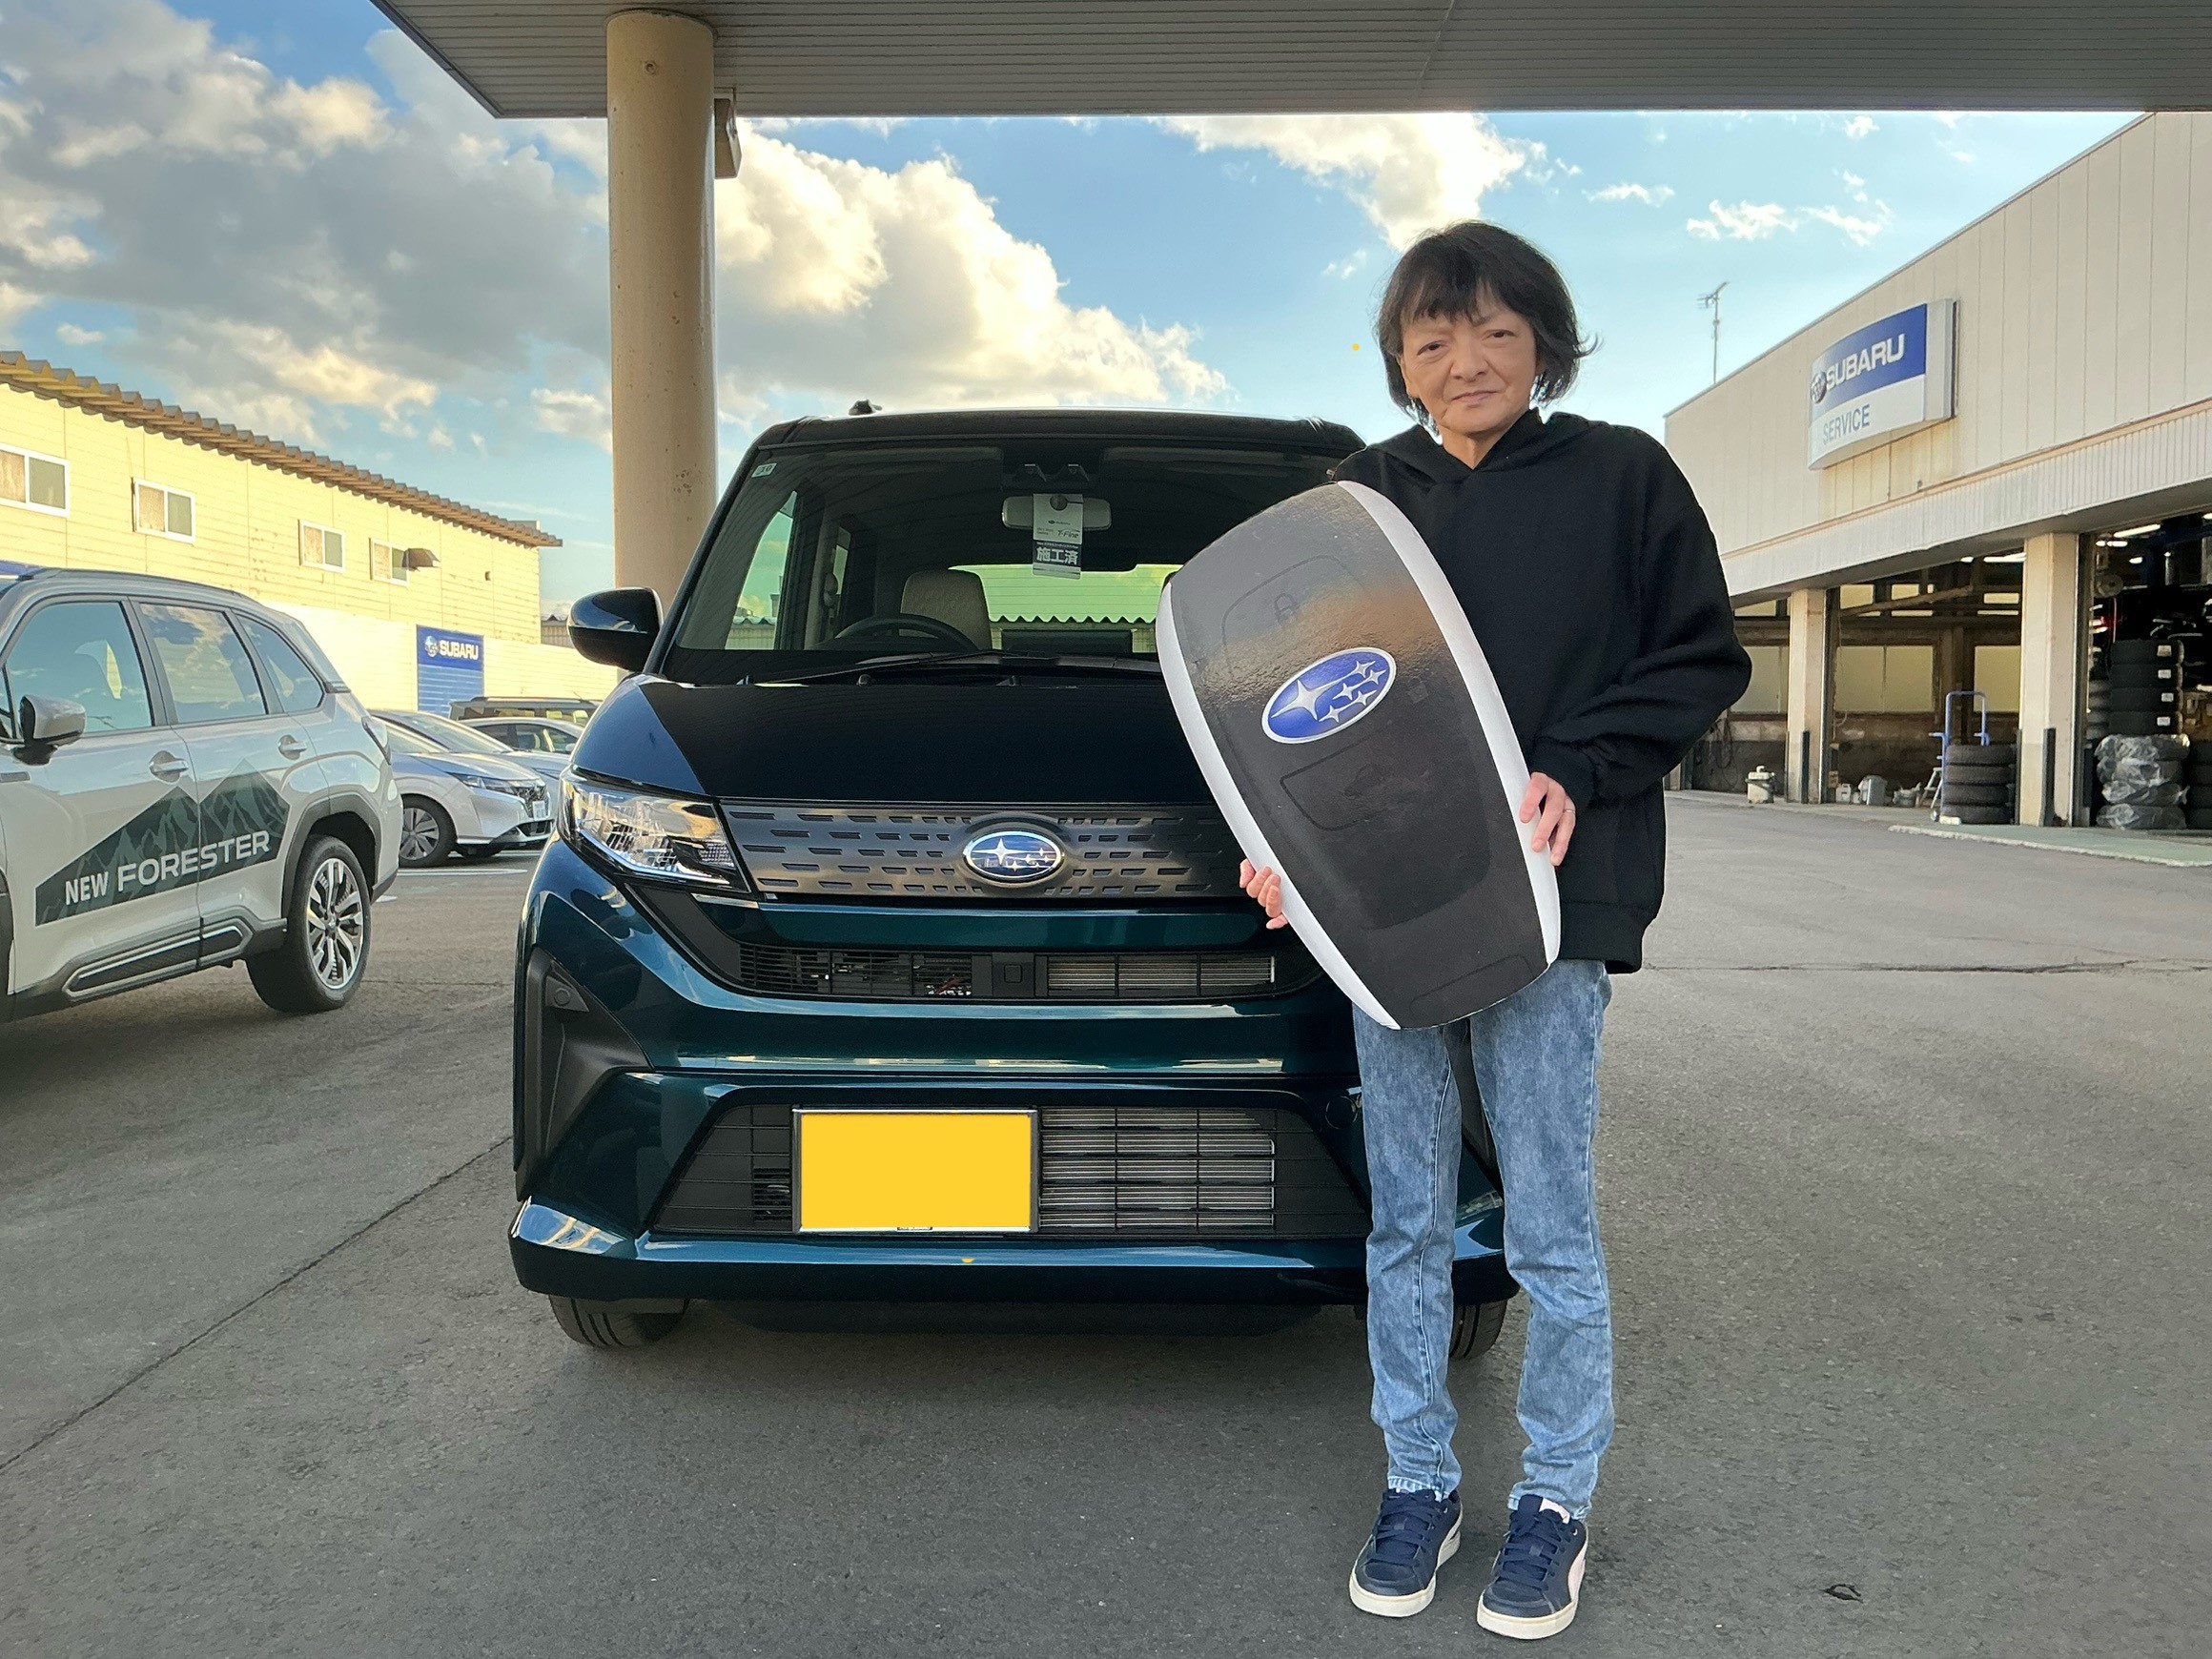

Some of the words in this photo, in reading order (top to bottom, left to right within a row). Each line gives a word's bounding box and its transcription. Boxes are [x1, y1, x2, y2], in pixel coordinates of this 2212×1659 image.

[1826, 334, 1905, 391] SUBARU
[1823, 404, 1871, 444] SERVICE
[1036, 546, 1078, 564] 施工済
[440, 640, 479, 660] SUBARU
[65, 871, 109, 905] NEW
[117, 830, 271, 891] FORESTER
